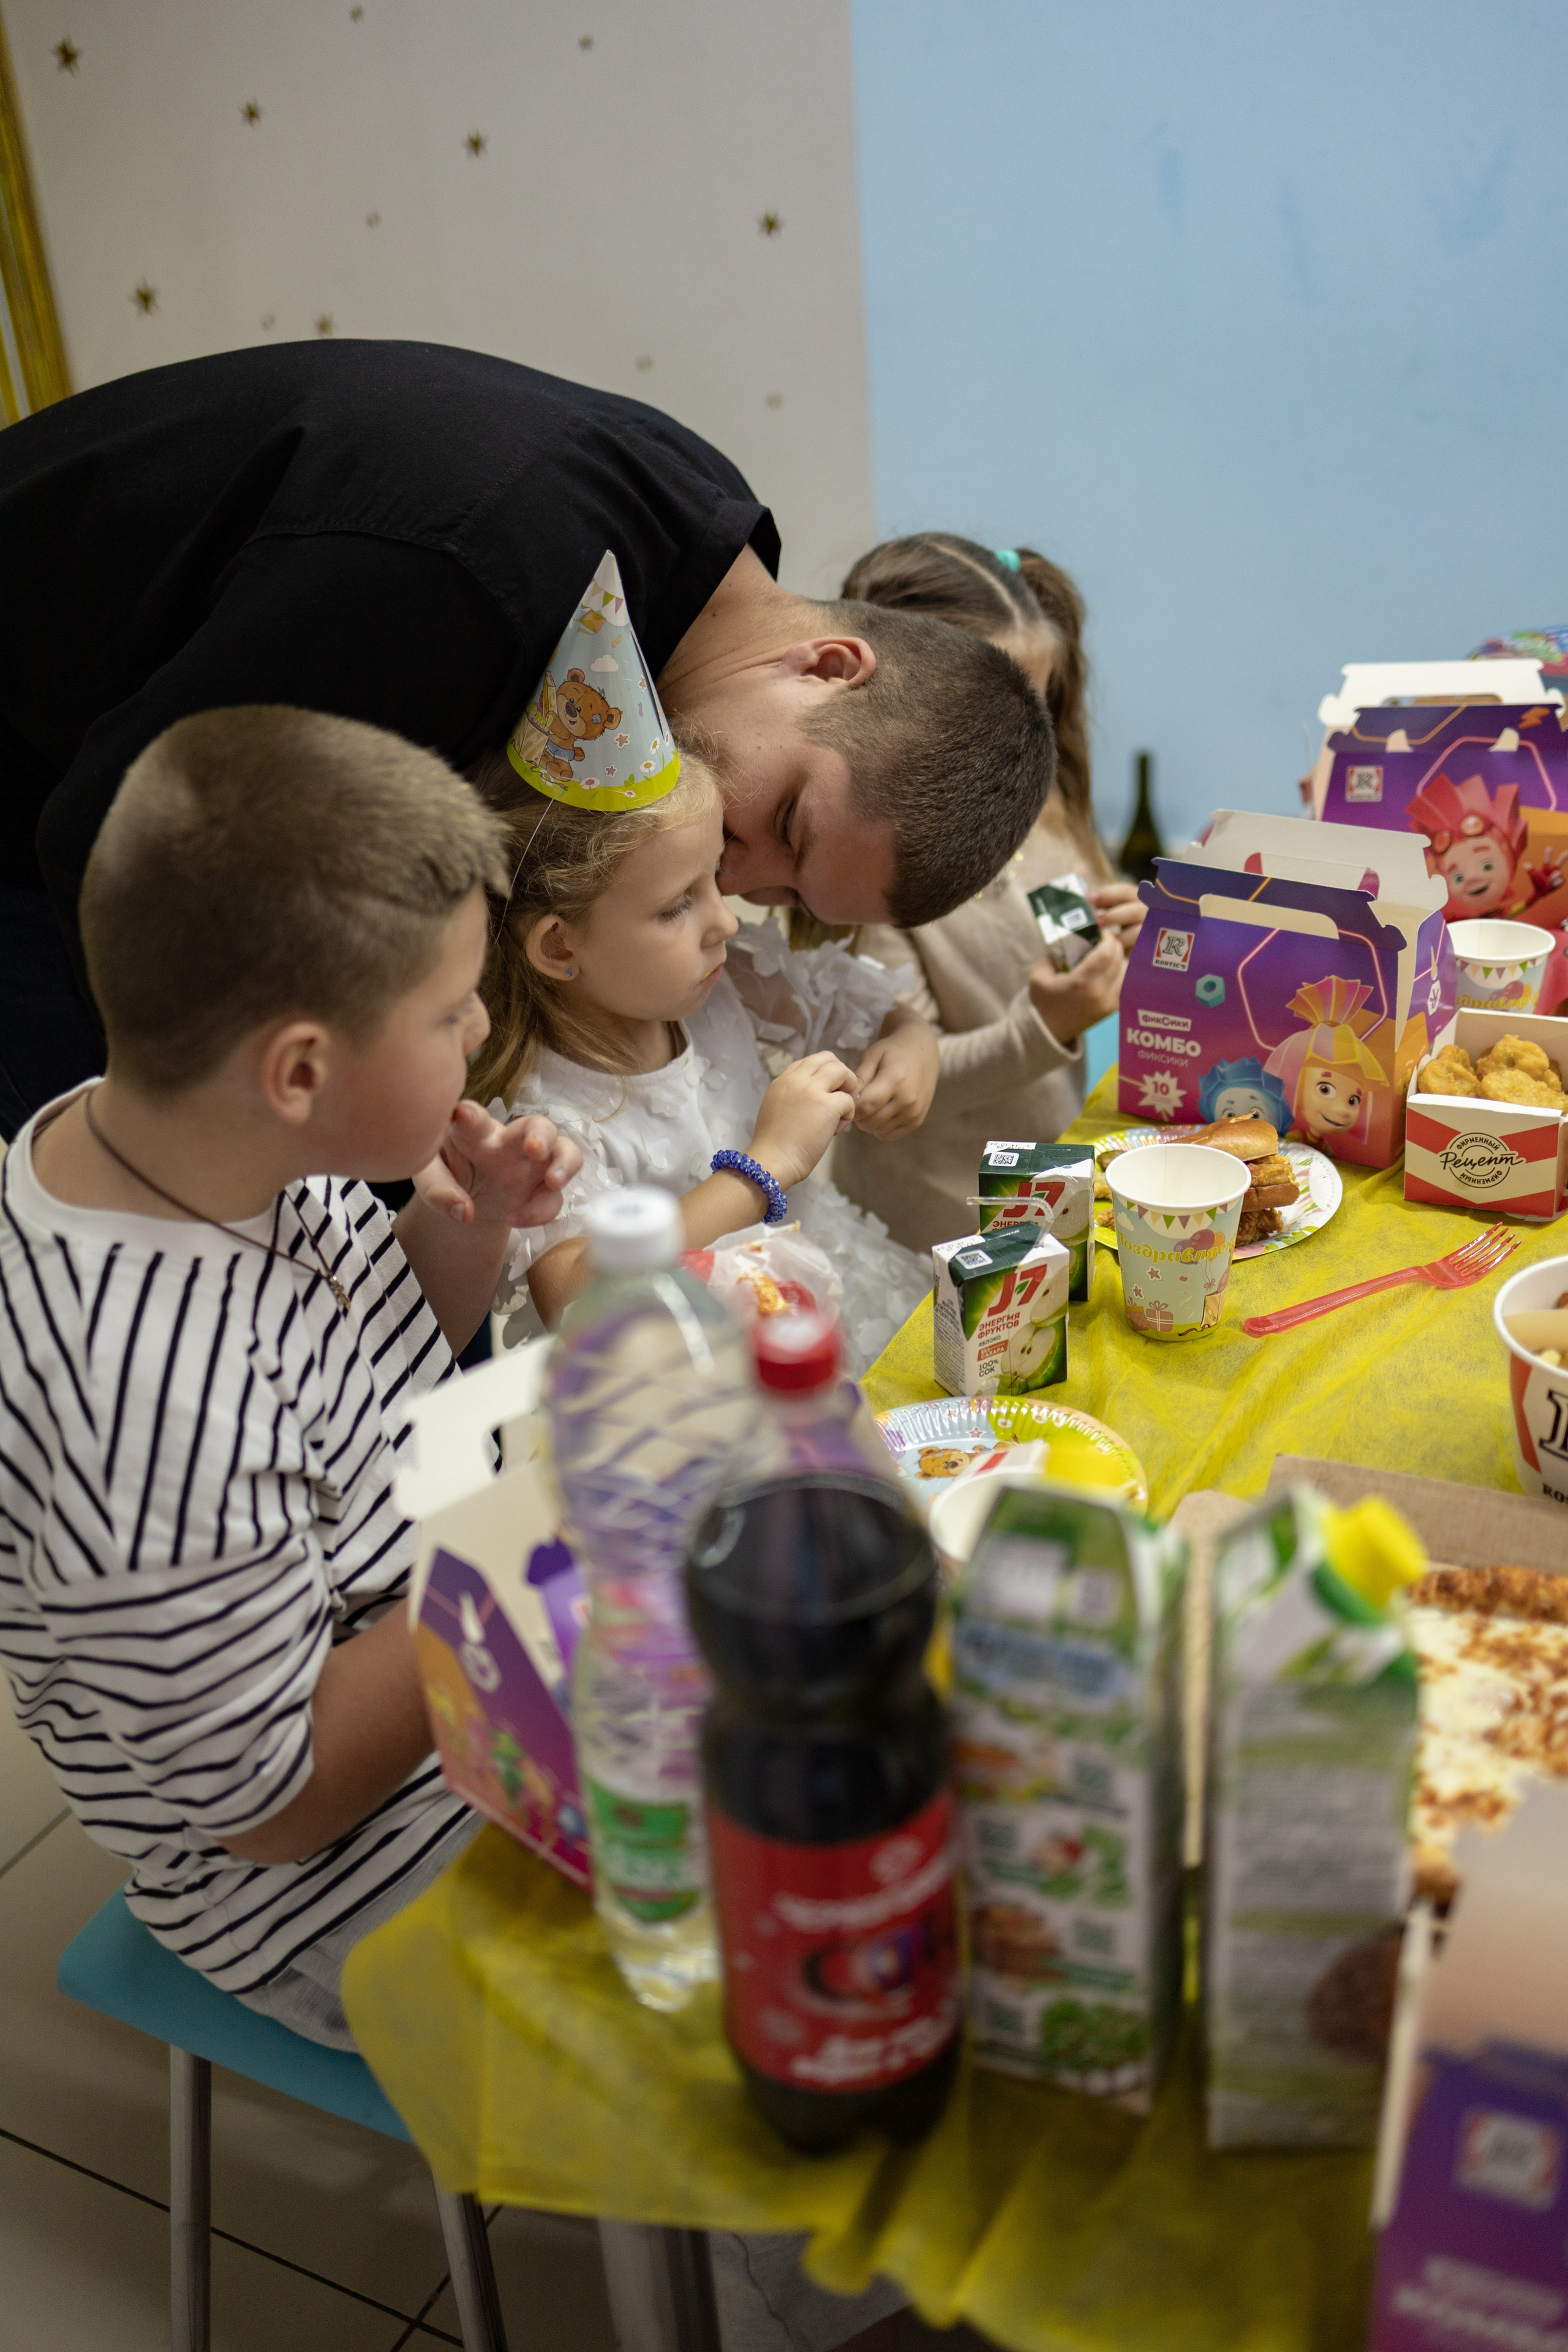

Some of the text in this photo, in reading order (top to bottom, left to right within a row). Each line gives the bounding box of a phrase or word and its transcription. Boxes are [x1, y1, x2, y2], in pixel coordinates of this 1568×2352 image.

[1163, 936, 1186, 957] R
[1155, 959, 1186, 970] ROSTIC'S
[1126, 1027, 1202, 1057] КОМБО
[1138, 1049, 1189, 1068] ФИКСИКИ
[1153, 1080, 1170, 1096] 10
[1457, 1136, 1501, 1151] ФИРМЕННЫЙ
[1439, 1152, 1524, 1170] Рецепт
[1459, 1170, 1502, 1185] ФИРМЕННЫЙ
[1003, 1182, 1066, 1218] J7
[987, 1264, 1047, 1317] J7
[978, 1320, 1019, 1339] ФРУКТОВ
[979, 1312, 1020, 1332] ЭНЕРГИЯ
[978, 1335, 1001, 1348] ЯБЛОКО
[981, 1346, 1005, 1359] САХАРА
[979, 1359, 999, 1371] 100%
[979, 1366, 995, 1378] СОК
